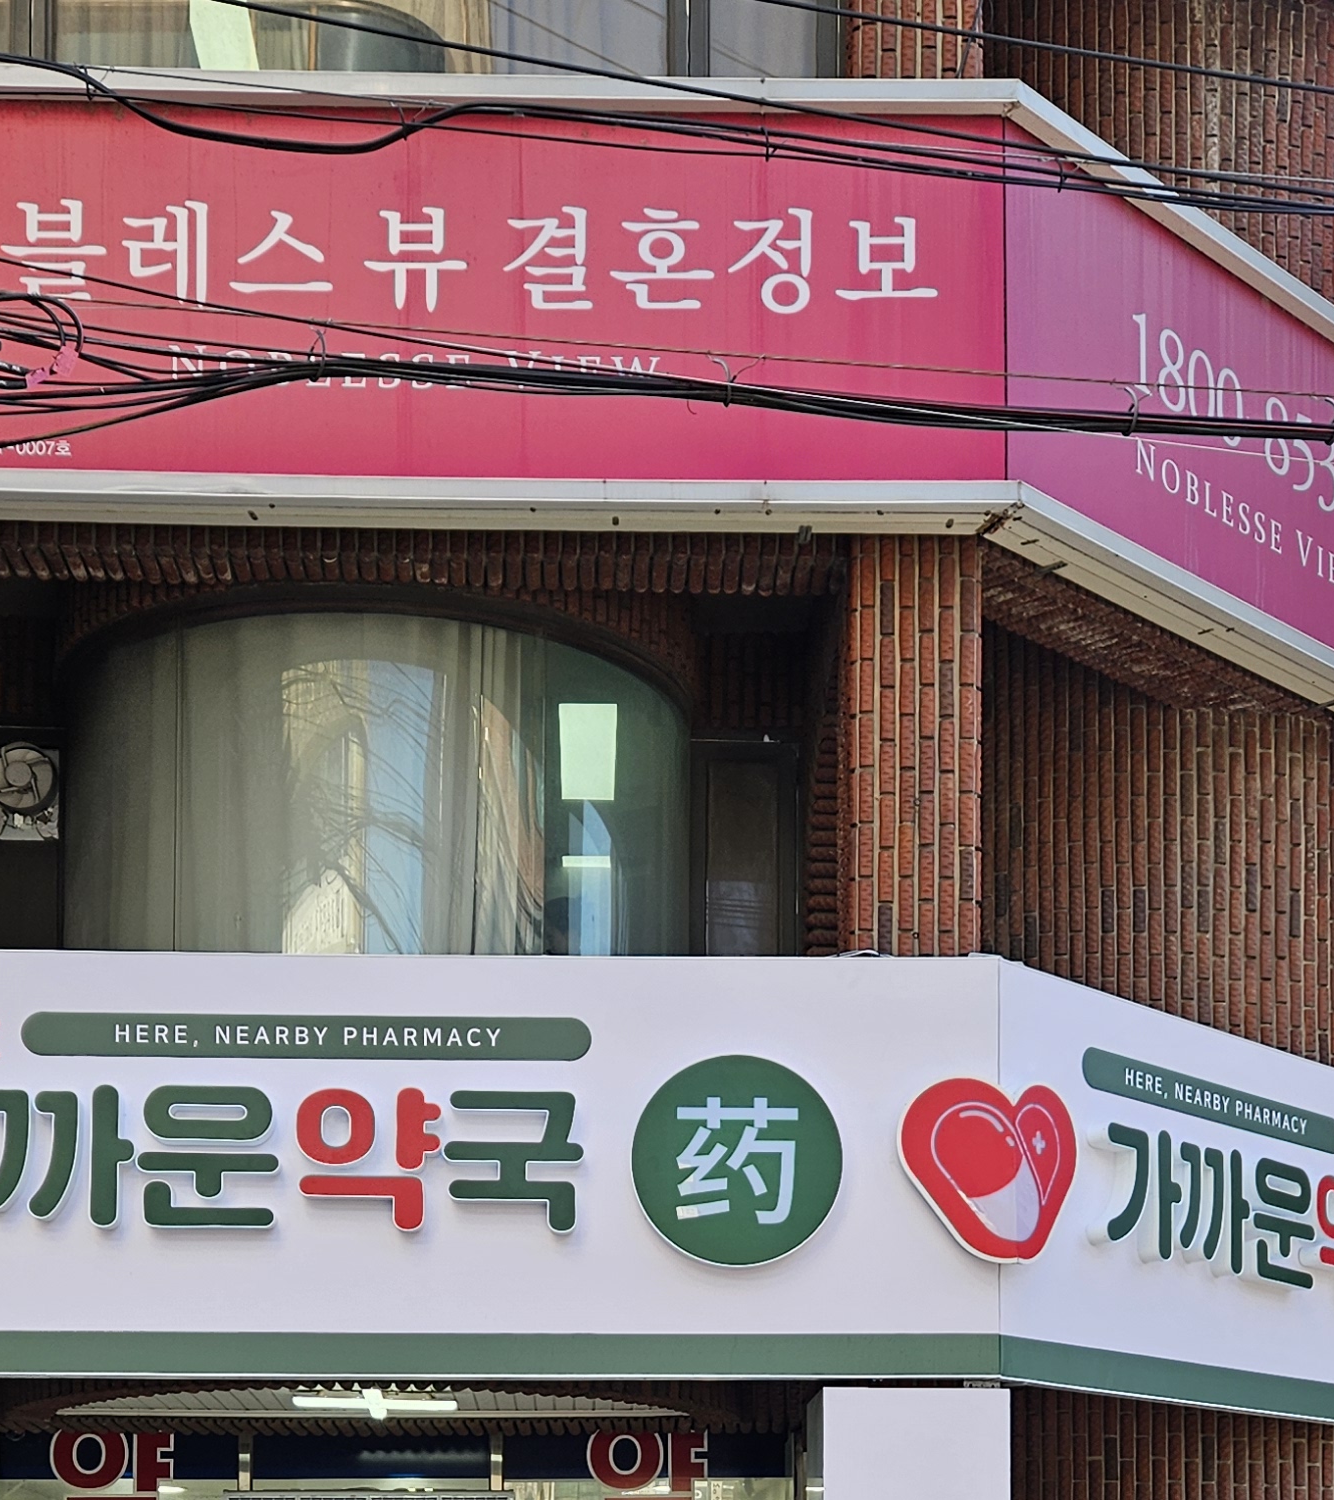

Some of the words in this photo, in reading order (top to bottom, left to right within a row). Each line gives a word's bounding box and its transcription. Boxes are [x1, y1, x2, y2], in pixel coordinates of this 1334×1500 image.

[503, 206, 938, 314] 결혼정보
[1134, 437, 1282, 555] NOBLESSE
[114, 1023, 200, 1050] HERE,
[215, 1024, 329, 1048] NEARBY
[343, 1025, 502, 1049] PHARMACY
[1123, 1066, 1170, 1100] HERE,
[1173, 1080, 1232, 1116] NEARBY
[1234, 1093, 1309, 1136] PHARMACY
[675, 1096, 799, 1226] 药
